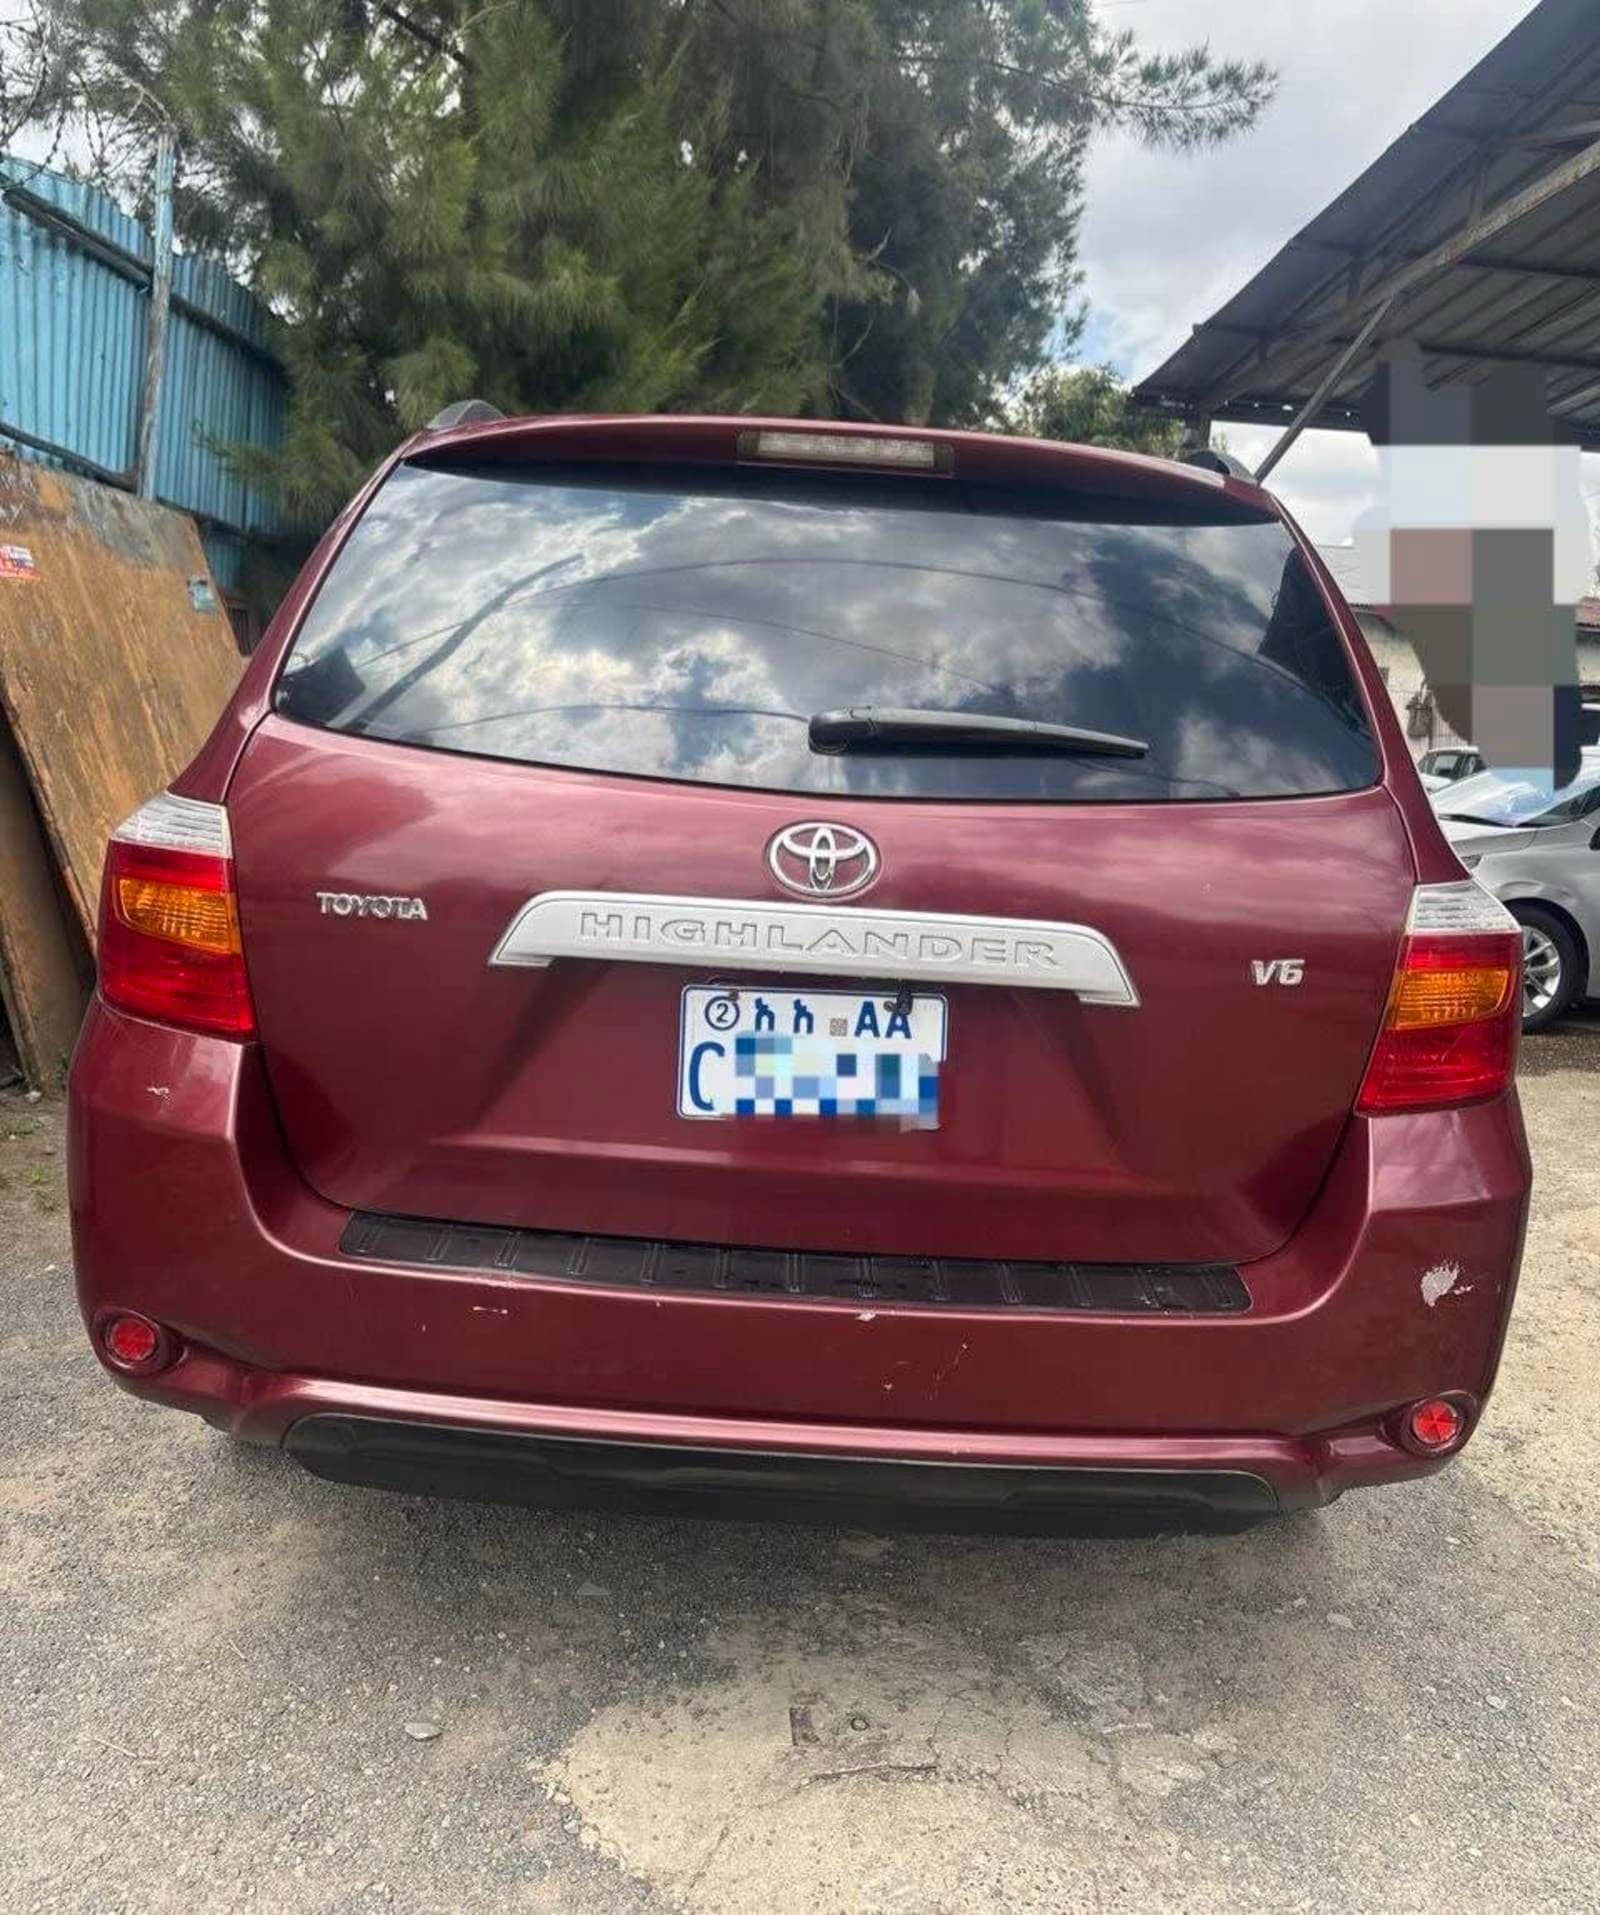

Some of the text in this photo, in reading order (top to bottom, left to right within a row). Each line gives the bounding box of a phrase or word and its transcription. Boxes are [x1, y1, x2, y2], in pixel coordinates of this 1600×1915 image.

[316, 892, 427, 920] TOYOTA
[579, 912, 1061, 967] HIGHLANDER
[1251, 959, 1305, 986] V6
[854, 1001, 912, 1039] AA
